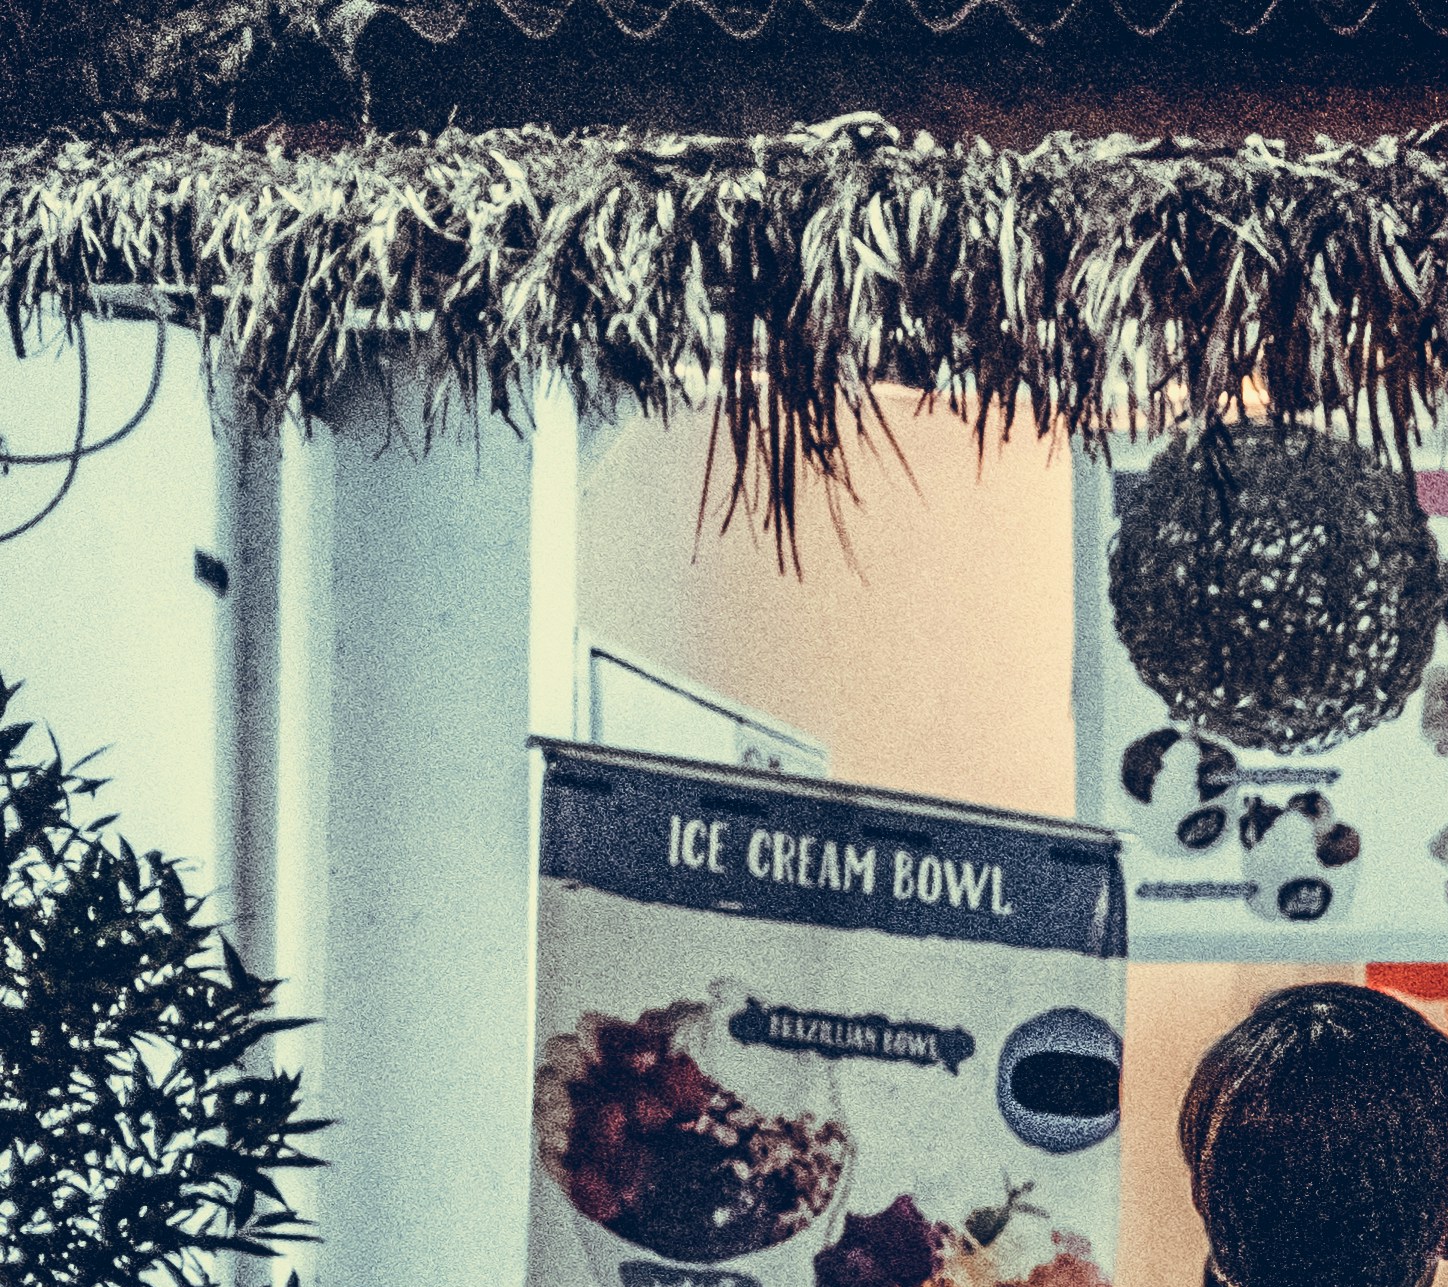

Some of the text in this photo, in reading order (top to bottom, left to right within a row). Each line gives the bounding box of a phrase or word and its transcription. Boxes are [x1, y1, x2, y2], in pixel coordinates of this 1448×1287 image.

[668, 815, 1013, 915] ICE CREAM BOWL
